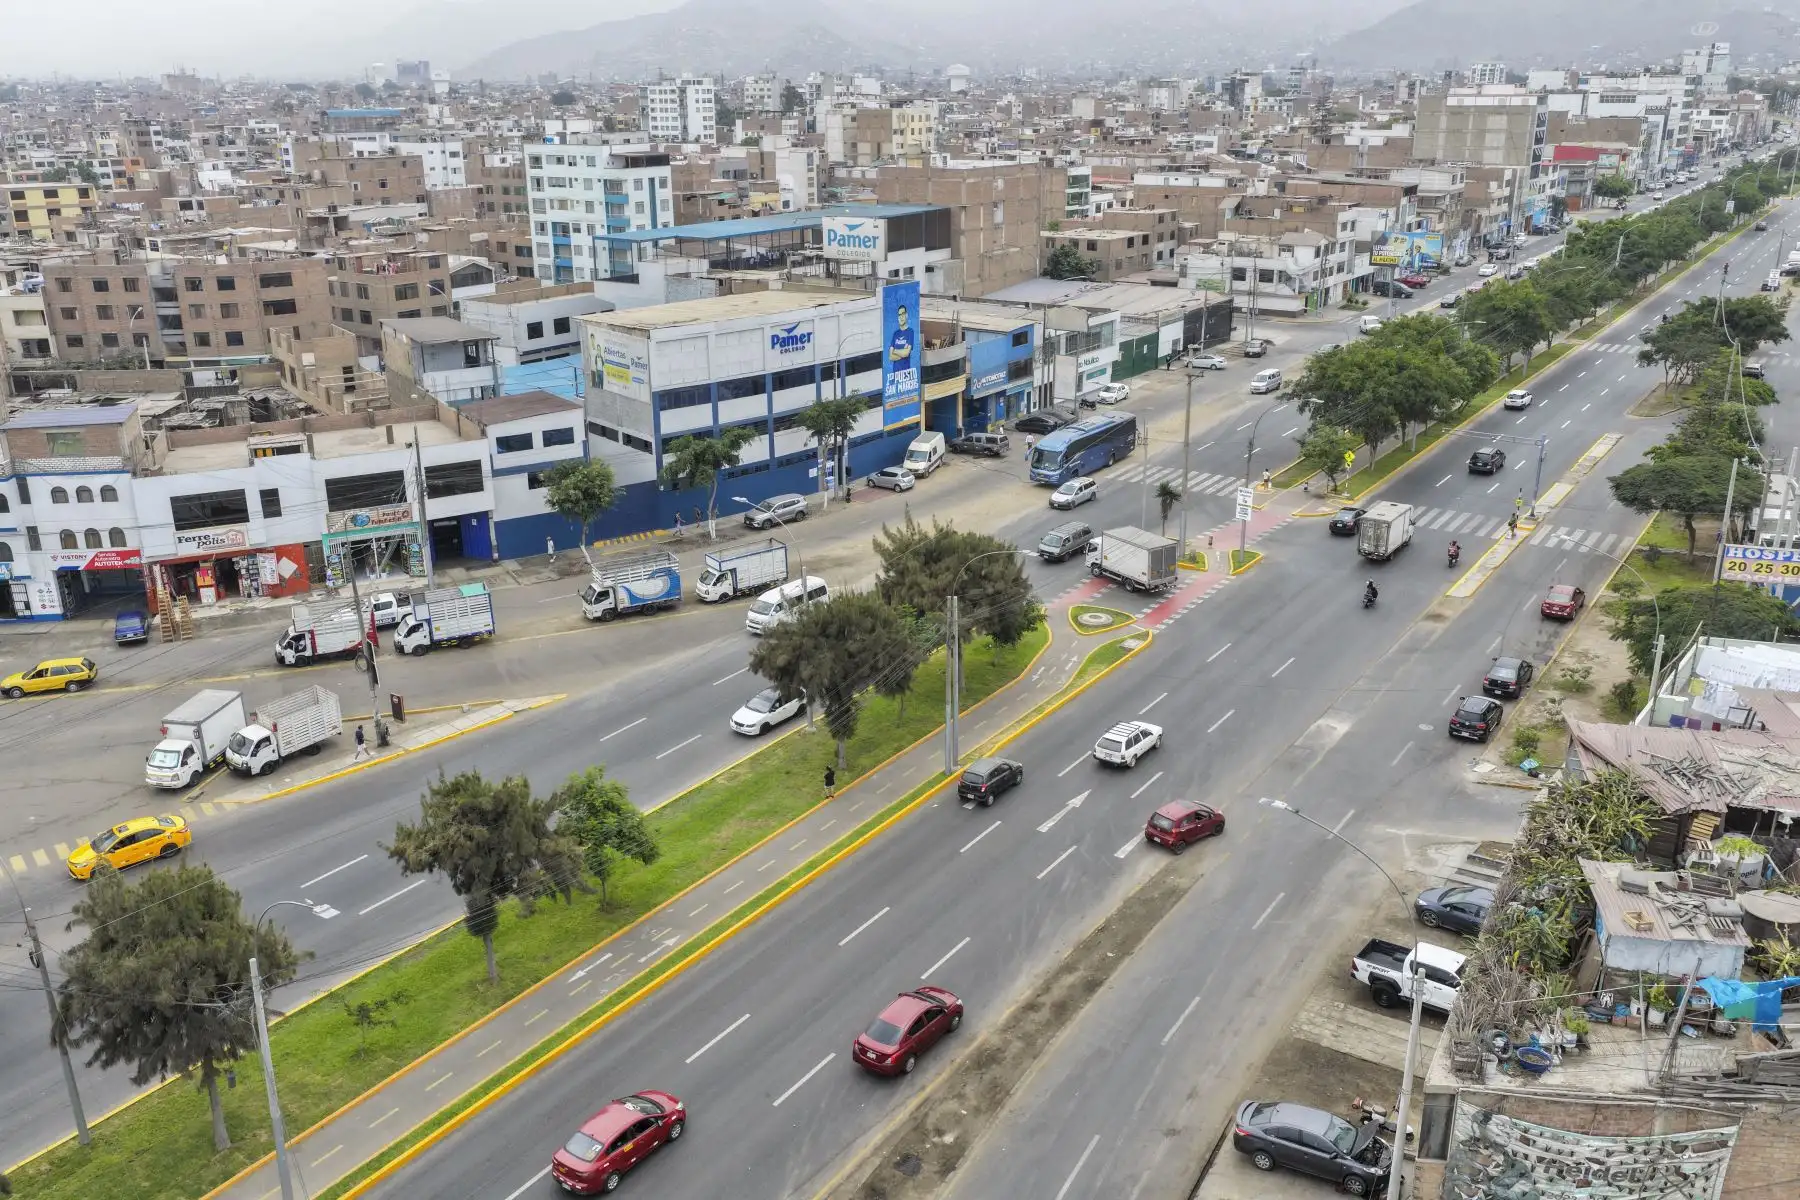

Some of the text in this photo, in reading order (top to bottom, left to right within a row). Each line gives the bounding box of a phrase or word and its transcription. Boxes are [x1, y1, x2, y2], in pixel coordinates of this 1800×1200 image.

[827, 228, 880, 249] Pamer
[771, 331, 813, 350] Pamer
[603, 345, 627, 360] Abiertas
[894, 367, 918, 384] PUESTO
[885, 384, 897, 397] SAN
[177, 533, 212, 545] Ferre
[197, 537, 227, 549] polis
[60, 553, 87, 561] VISTONY
[1728, 560, 1800, 576] 20 25 30
